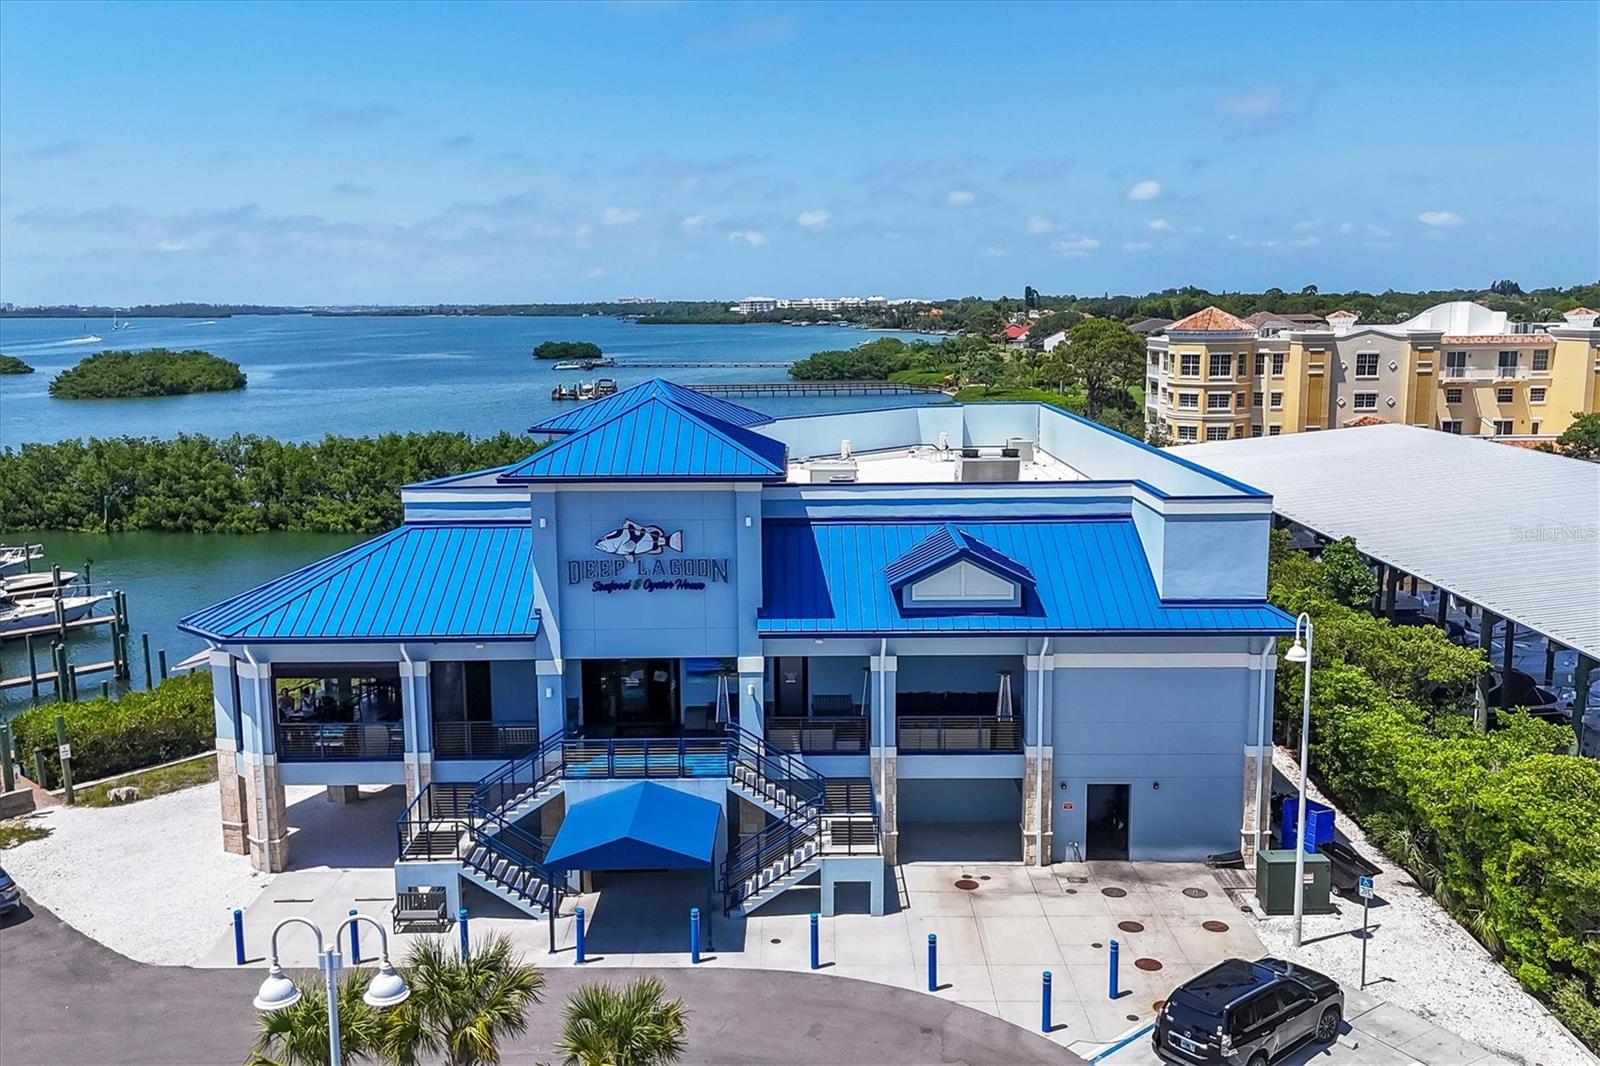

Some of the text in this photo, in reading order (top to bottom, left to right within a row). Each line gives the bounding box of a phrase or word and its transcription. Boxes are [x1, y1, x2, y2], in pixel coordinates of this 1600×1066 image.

[568, 558, 729, 585] DEEP LAGOON
[592, 579, 631, 594] Seafood
[643, 578, 674, 593] Oyster
[674, 578, 706, 590] House
